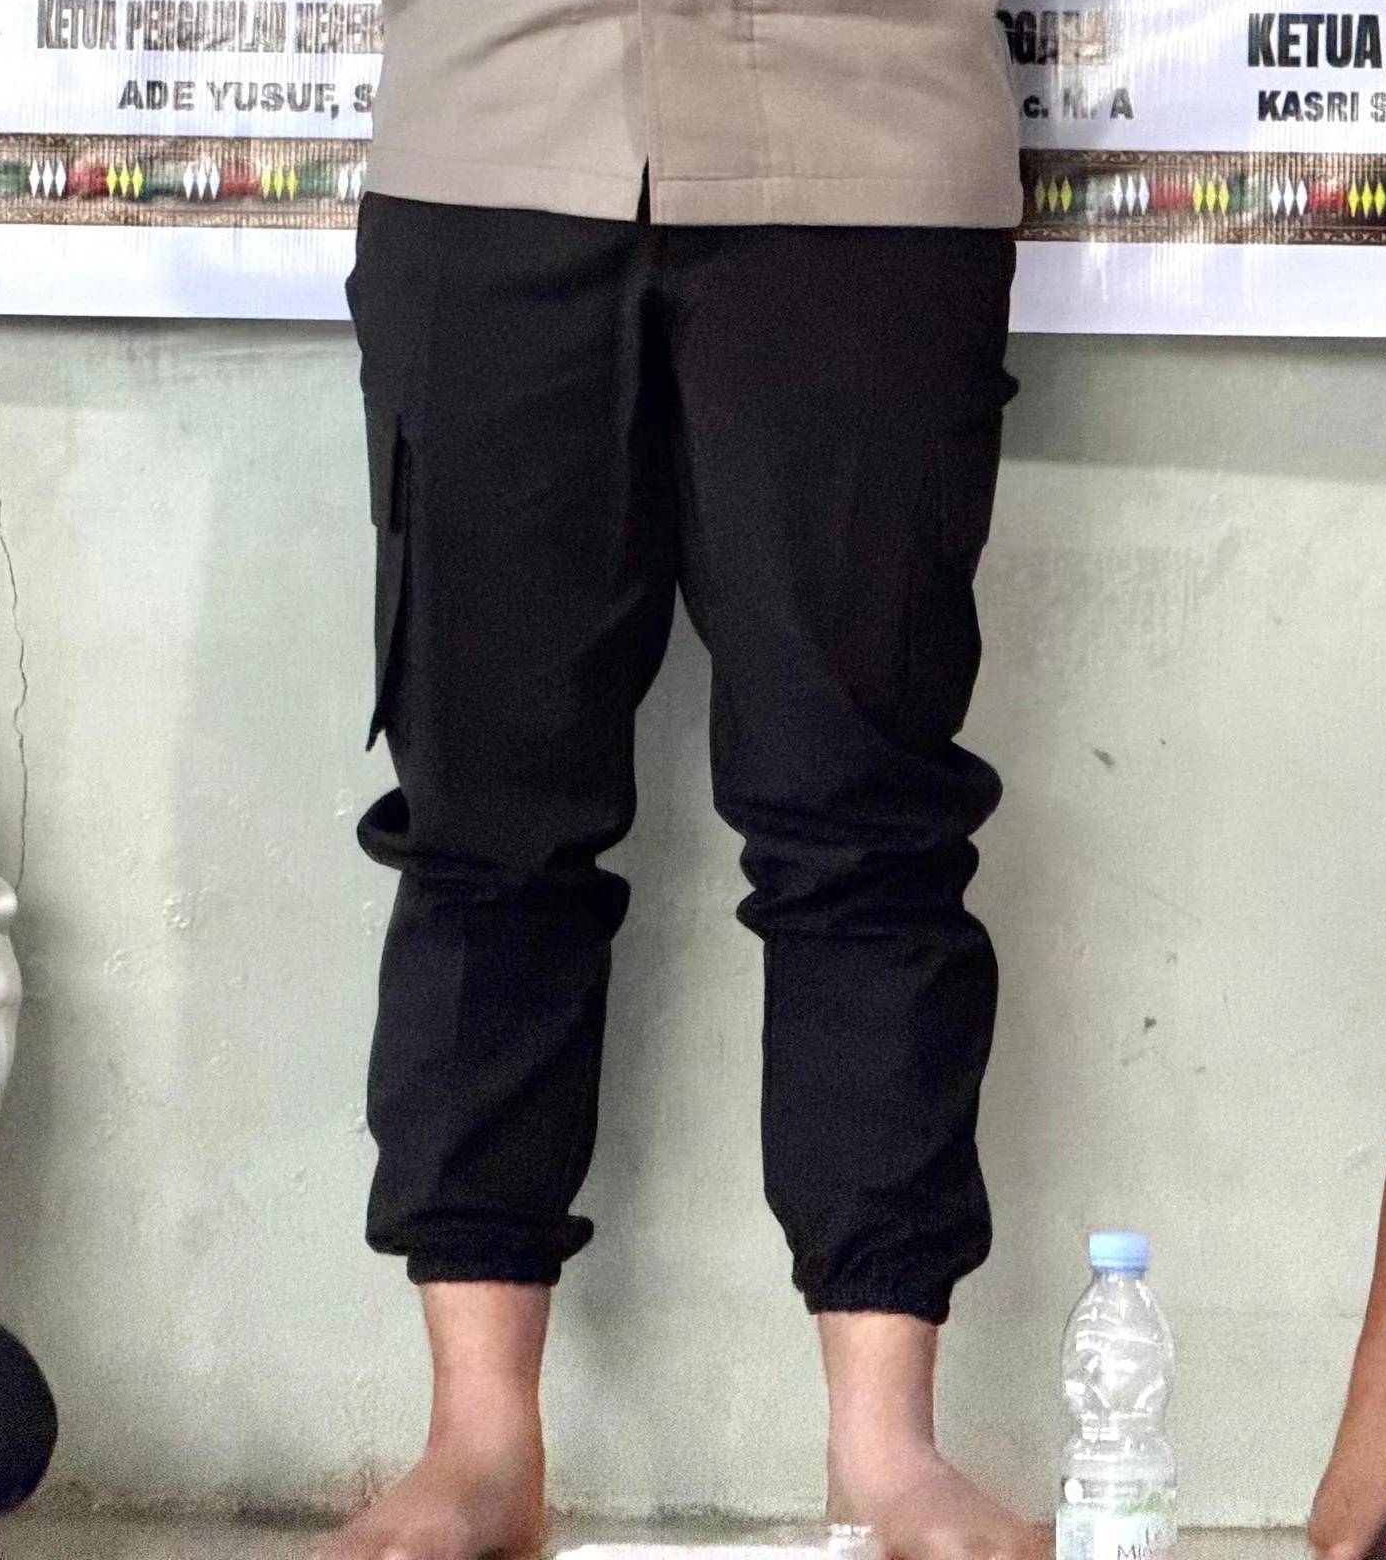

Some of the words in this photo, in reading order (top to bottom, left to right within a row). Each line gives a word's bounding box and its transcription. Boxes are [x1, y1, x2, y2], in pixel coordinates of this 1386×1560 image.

[125, 0, 288, 53] PENGADILAN
[1248, 13, 1383, 69] KETUA
[117, 80, 195, 111] ADE
[207, 81, 340, 120] YUSUF,
[1258, 90, 1360, 122] KASRI
